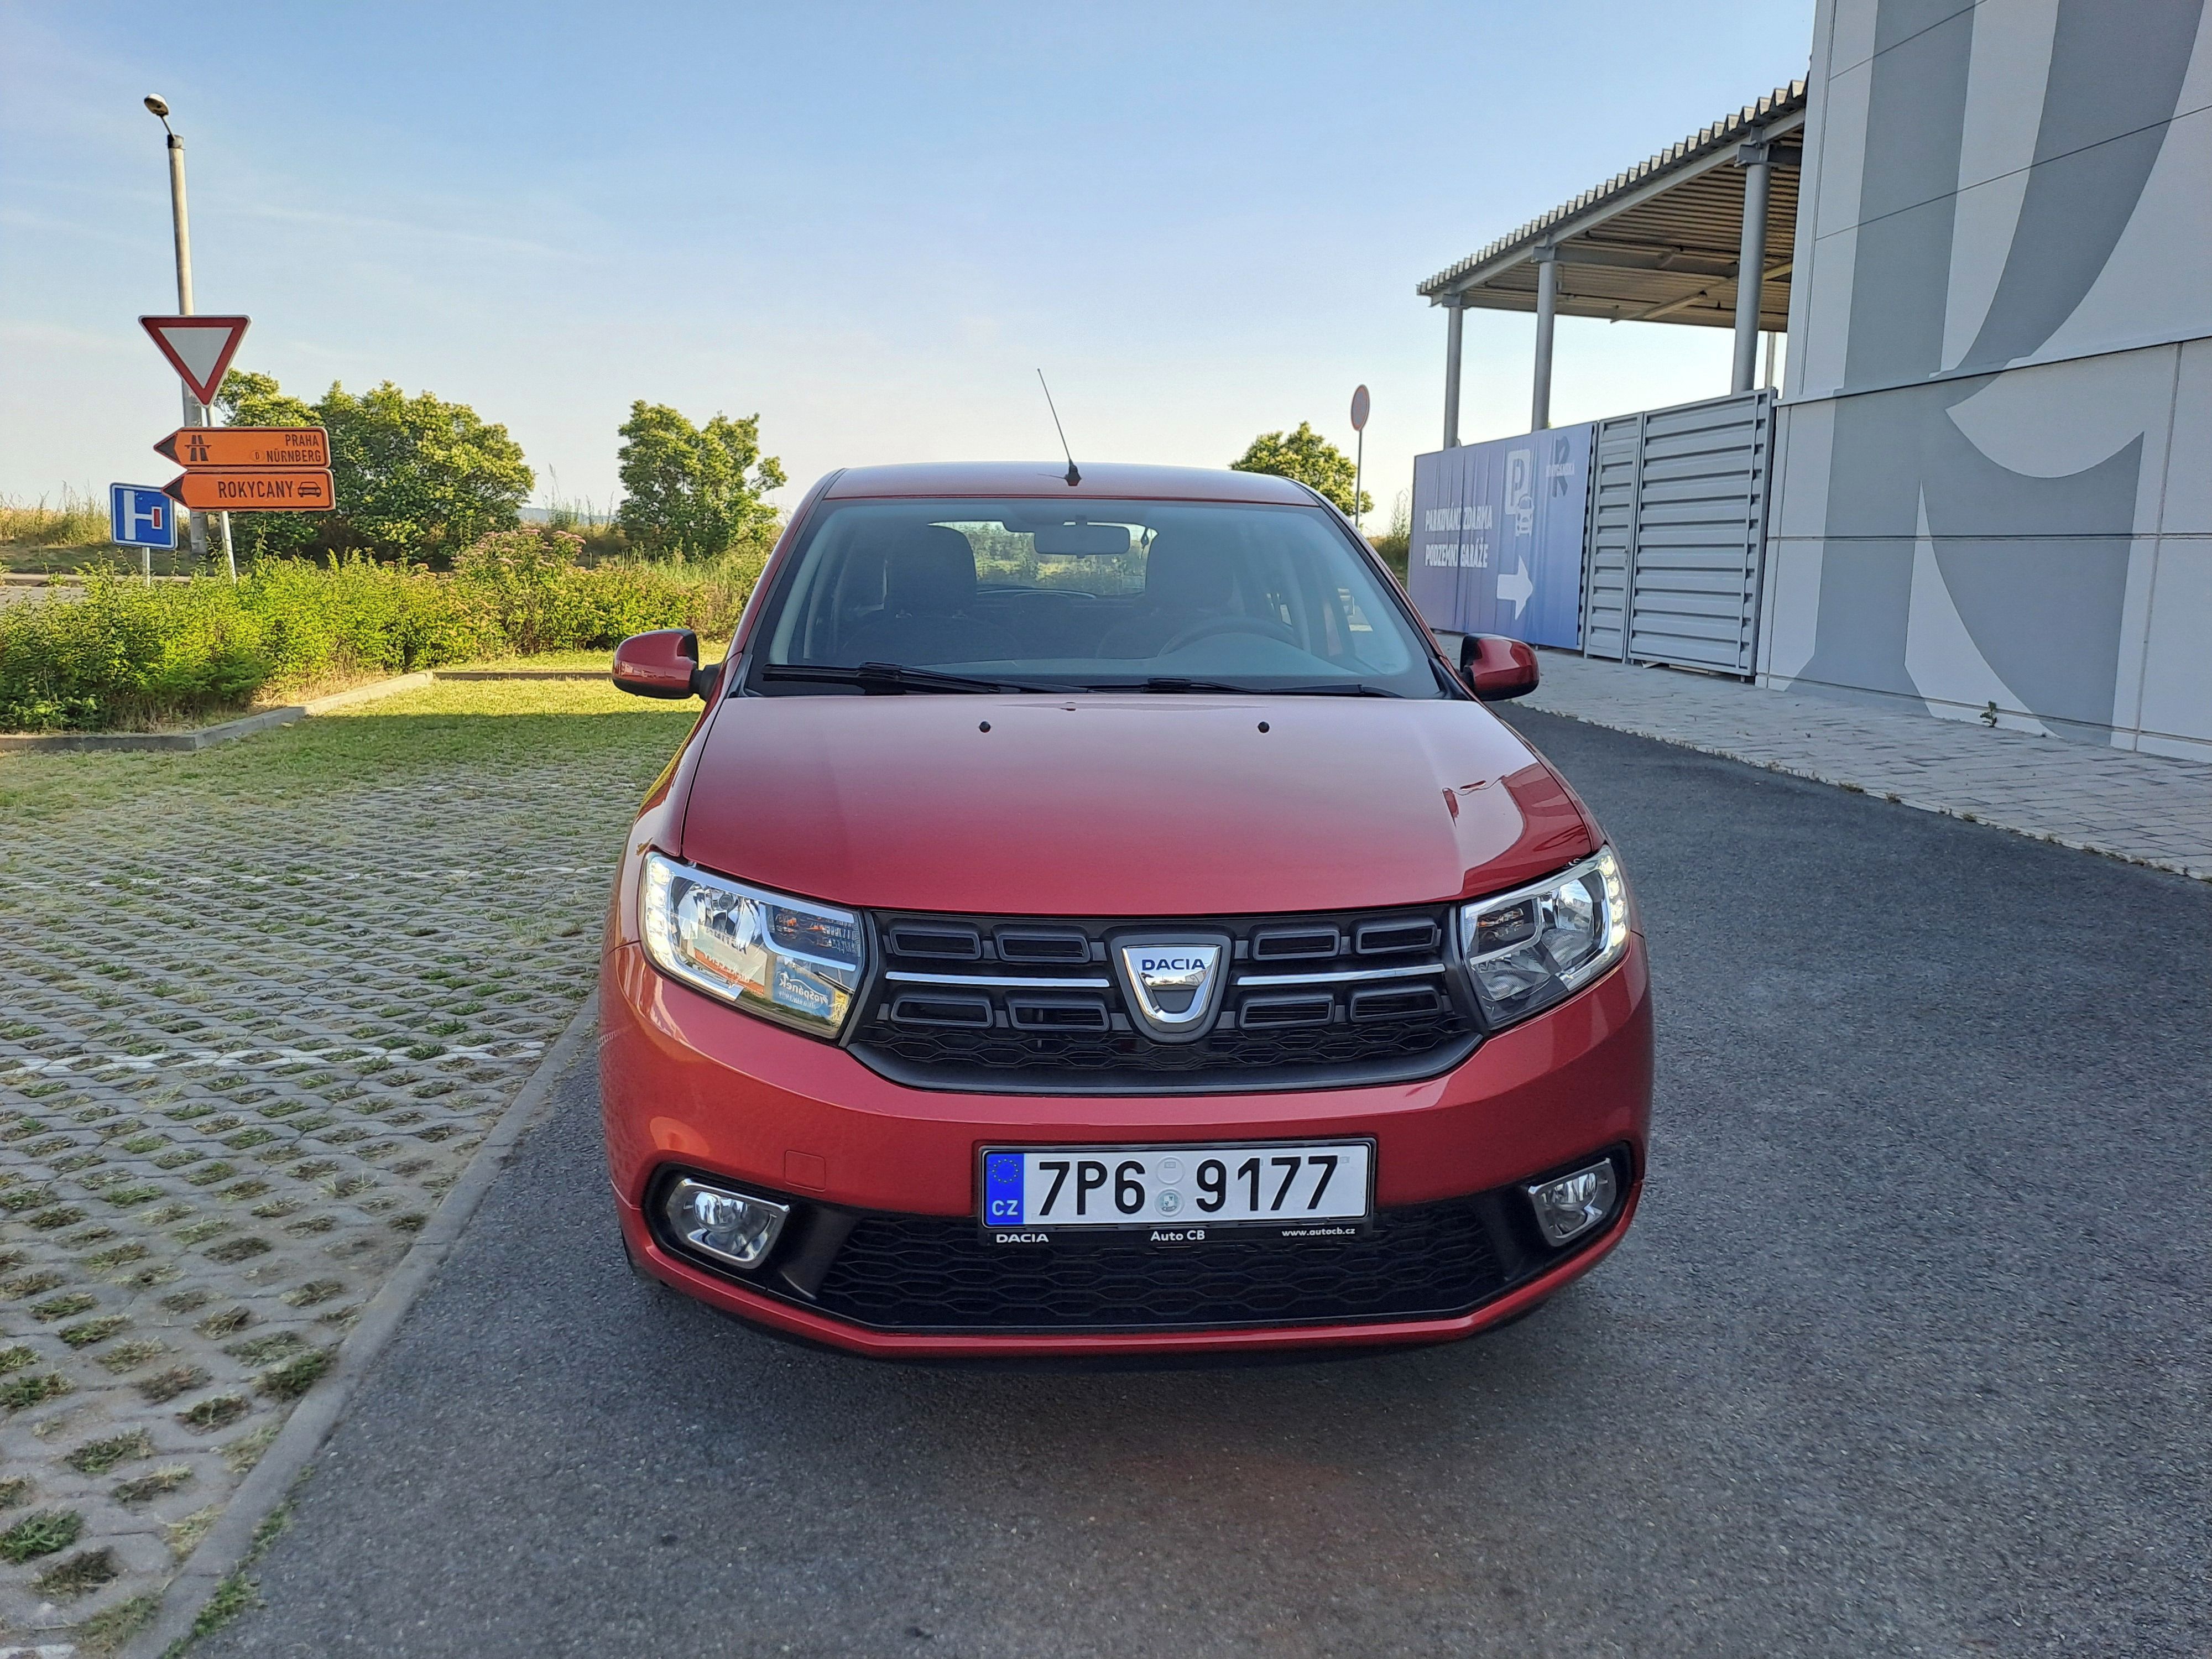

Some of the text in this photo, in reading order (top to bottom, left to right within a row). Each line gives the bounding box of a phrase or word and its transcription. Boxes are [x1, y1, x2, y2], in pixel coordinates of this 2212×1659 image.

[285, 434, 319, 447] PRAHA
[255, 448, 321, 462] D NÜRNBERG
[217, 481, 294, 498] ROKYCANY
[1463, 505, 1493, 530] ZDARMA
[1425, 536, 1489, 568] PODZEMNÍ GARÁŽE
[1141, 959, 1206, 971] DACIA
[1039, 1155, 1338, 1216] 7P6 9177
[992, 1199, 1018, 1216] CZ
[996, 1234, 1050, 1243] DACIA
[1150, 1229, 1206, 1241] Auto CB
[1281, 1227, 1356, 1236] www.autocb.cz
